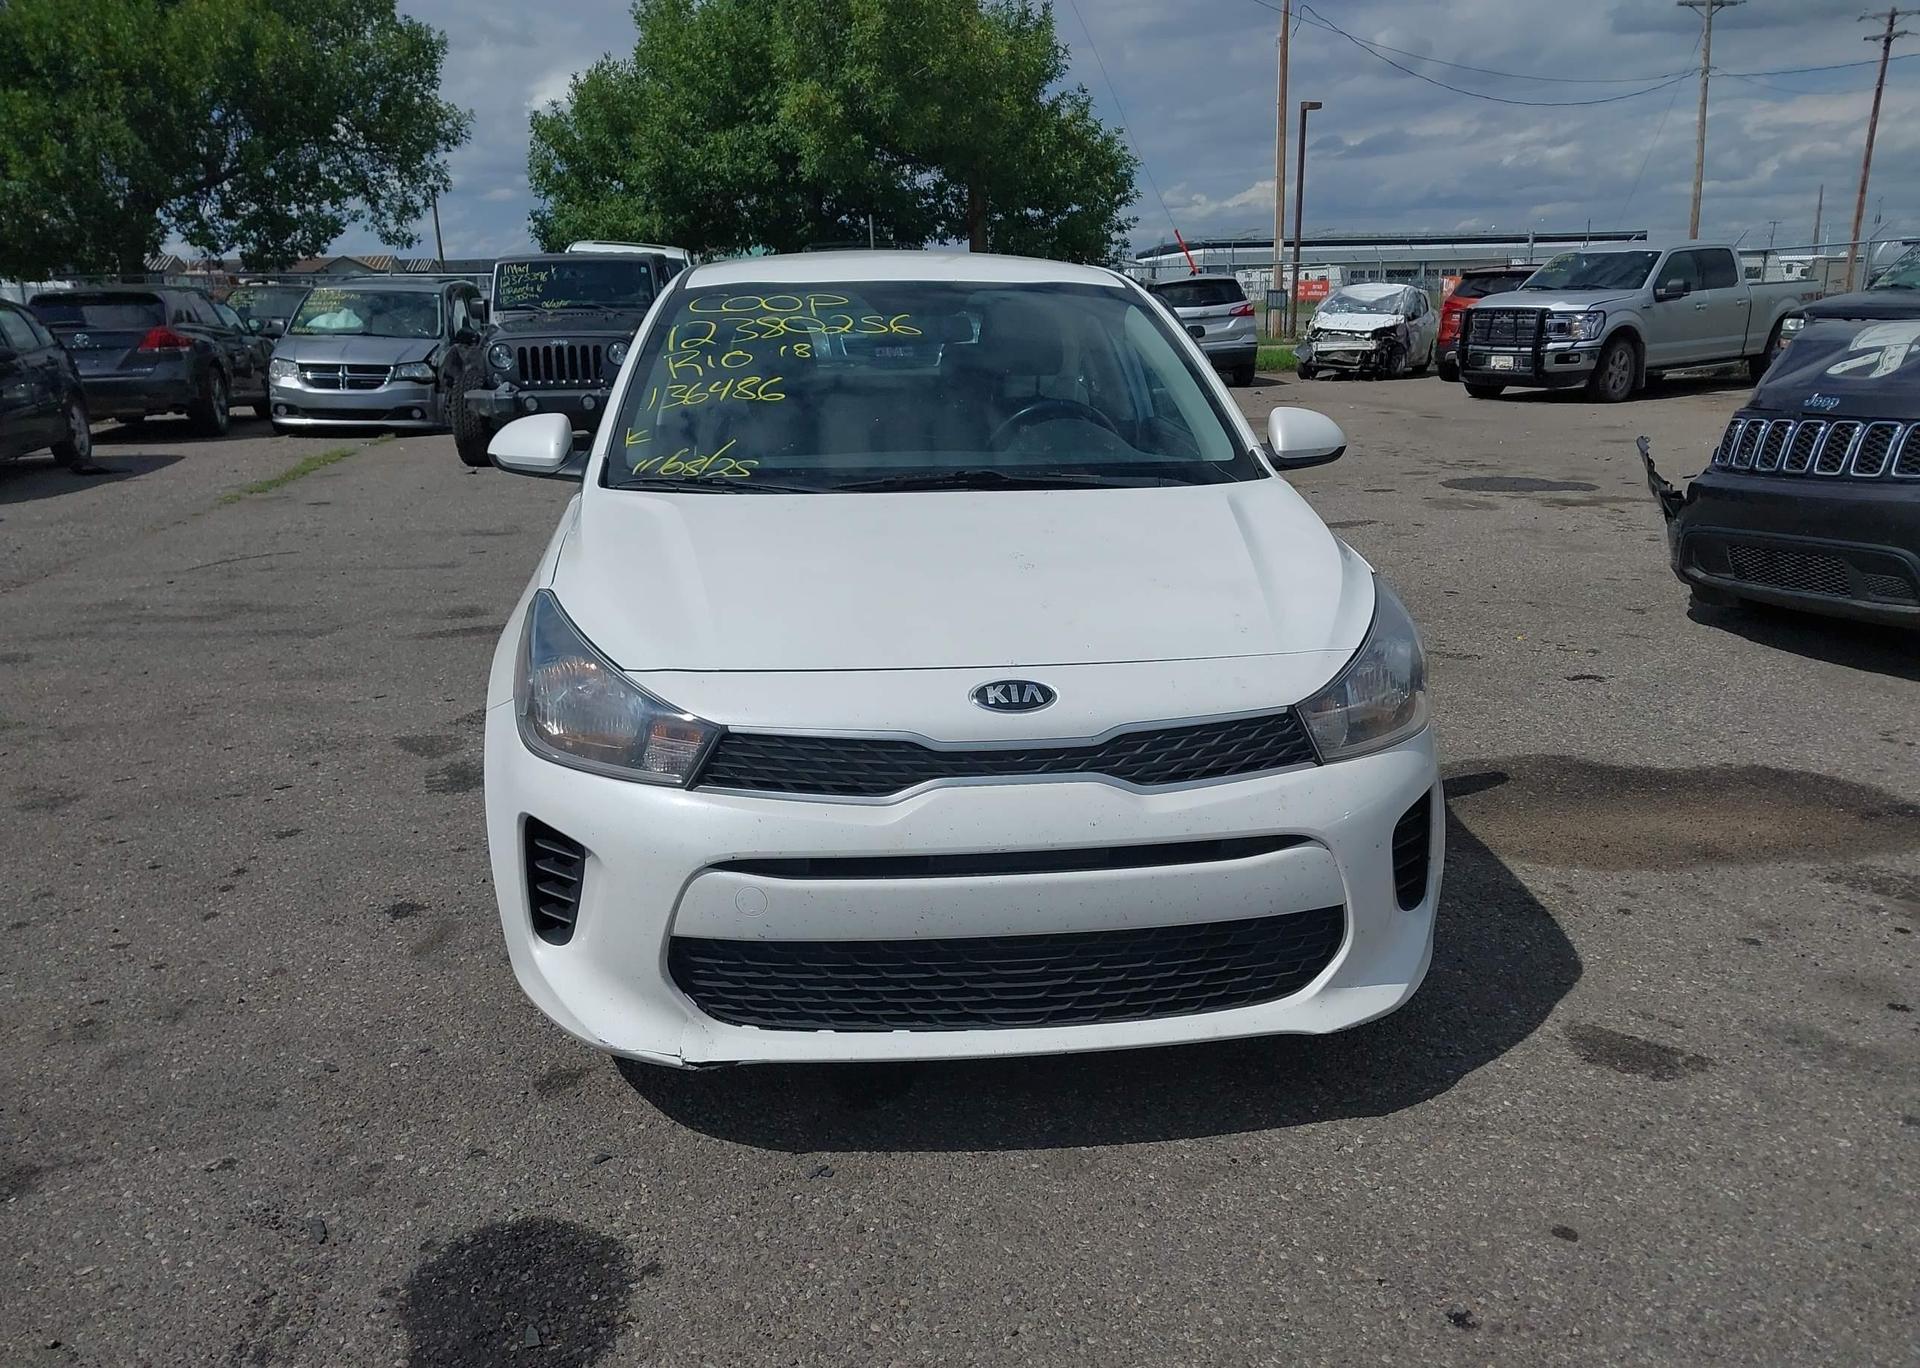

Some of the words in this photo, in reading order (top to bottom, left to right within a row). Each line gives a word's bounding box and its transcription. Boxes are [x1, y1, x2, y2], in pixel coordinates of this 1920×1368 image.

[689, 293, 849, 317] COOP
[668, 314, 923, 352] 12380256
[646, 376, 786, 412] 136486
[1804, 392, 1840, 411] Jeep
[985, 683, 1045, 705] KIA
